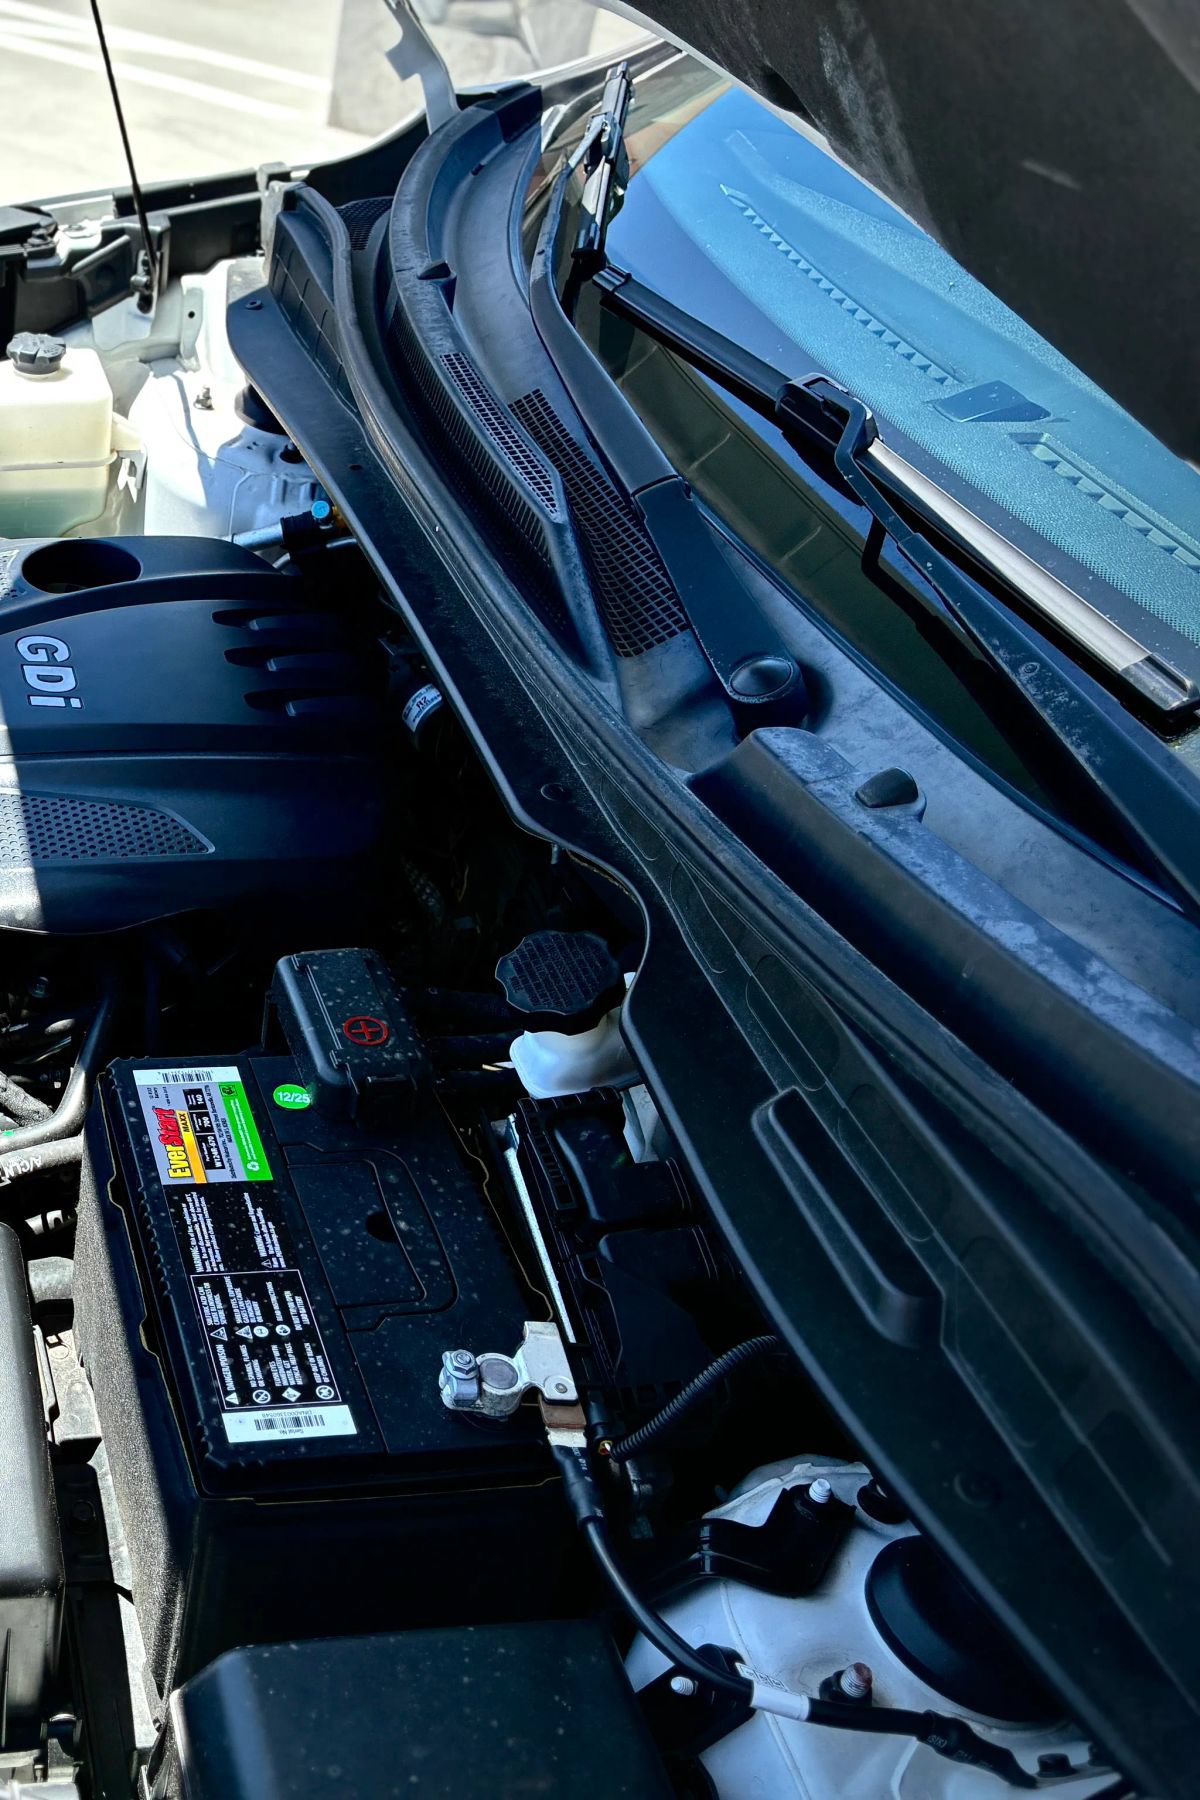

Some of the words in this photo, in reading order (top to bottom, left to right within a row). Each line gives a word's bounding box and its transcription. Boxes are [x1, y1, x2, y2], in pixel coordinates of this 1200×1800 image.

[15, 634, 83, 709] GDi
[277, 1091, 311, 1104] 12/25
[179, 1113, 190, 1132] MAXX
[152, 1107, 192, 1178] EverStart
[255, 1235, 266, 1256] WARNING:
[191, 1246, 203, 1272] WARNING:
[224, 1277, 235, 1297] EXPLOSIVE
[234, 1288, 242, 1300] CAUSE
[206, 1289, 216, 1311] BLINDNESS
[267, 1282, 279, 1310] INSTRUCTIONS
[285, 1291, 293, 1301] OPEN
[295, 1296, 306, 1313] BATTERY
[234, 1309, 242, 1323] SHIELD
[241, 1310, 249, 1323] GASES
[292, 1316, 300, 1324] NOT
[240, 1345, 249, 1361] FLAMES
[305, 1343, 313, 1356] REACH
[217, 1345, 234, 1390] DANGER/POISON
[269, 1361, 277, 1372] EYES
[288, 1354, 296, 1365] HELP
[310, 1363, 318, 1372] OUT
[317, 1356, 327, 1376] CHILDREN
[252, 1360, 263, 1379] SMOKING
[293, 1366, 302, 1384] MEDICAL
[313, 1372, 321, 1383] KEEP
